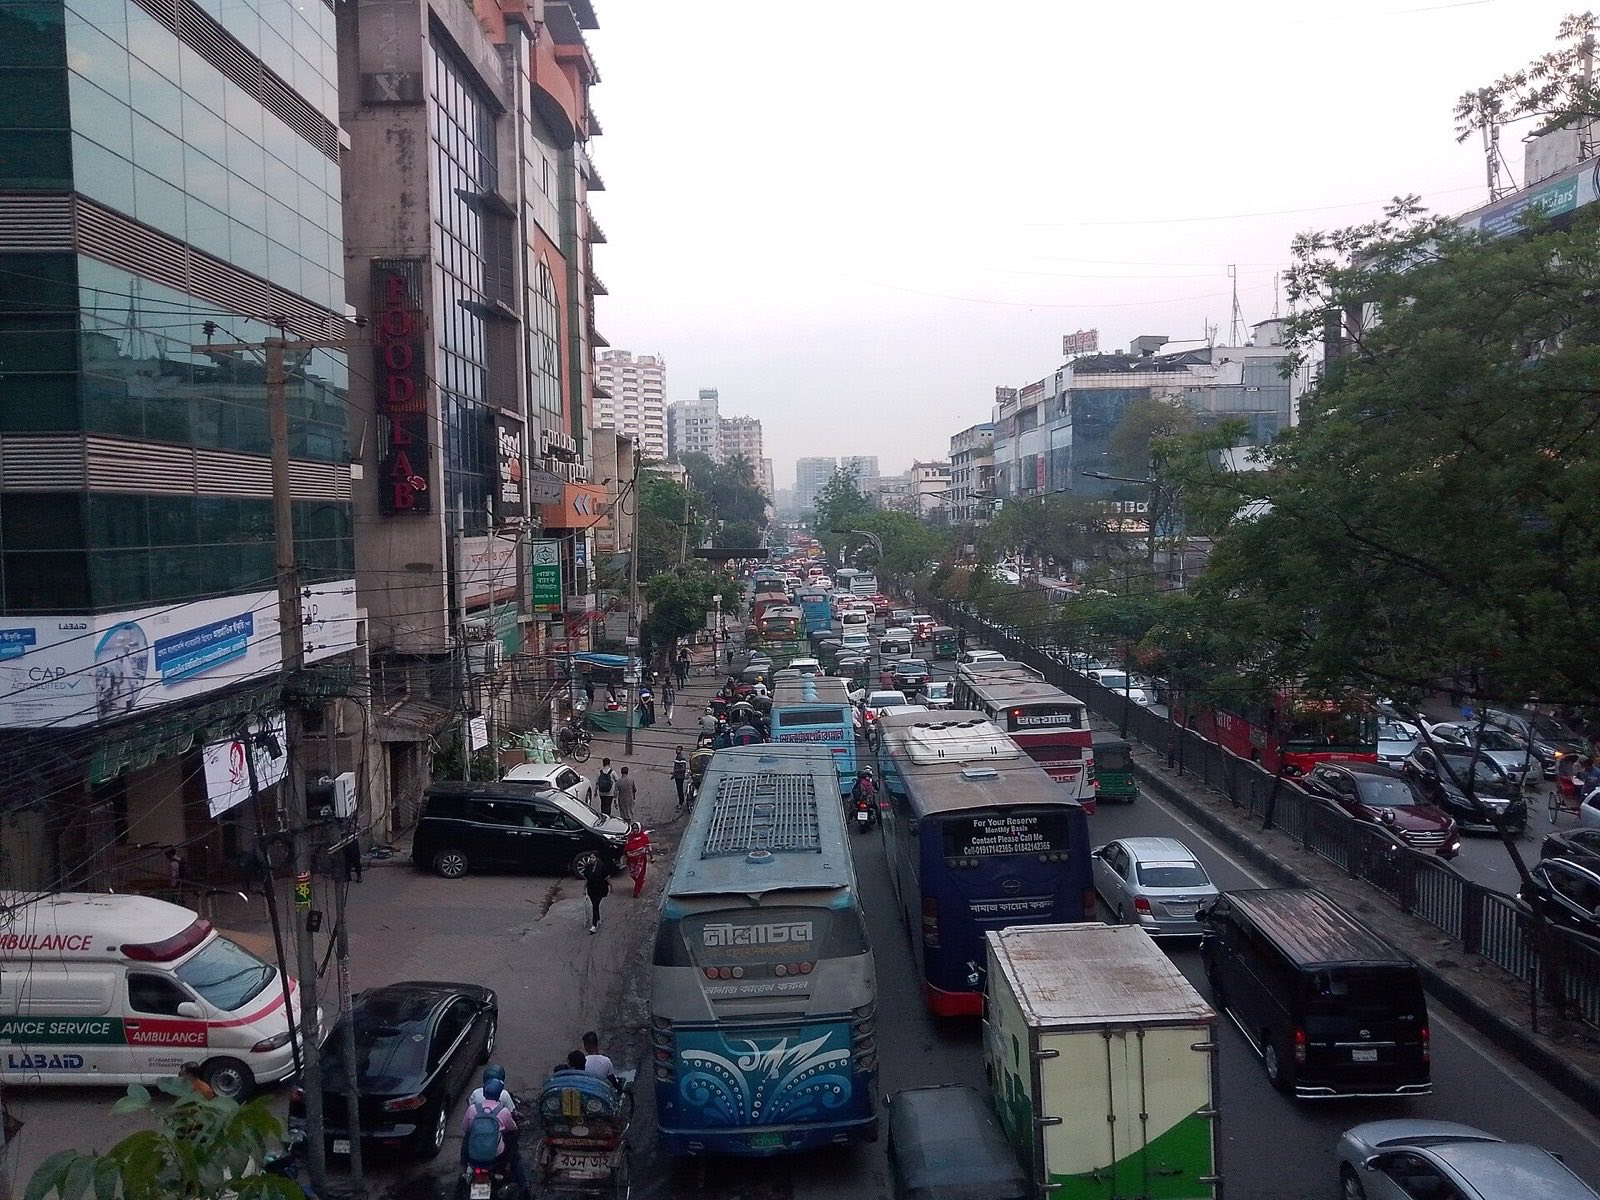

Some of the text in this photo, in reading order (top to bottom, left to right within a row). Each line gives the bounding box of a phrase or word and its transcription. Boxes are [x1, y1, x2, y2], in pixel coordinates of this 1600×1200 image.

[28, 666, 66, 681] CAP
[973, 817, 1038, 827] For Your Reserve
[985, 826, 1010, 834] Monthly
[971, 836, 997, 845] Contact
[997, 834, 1019, 843] Please
[1019, 833, 1033, 842] Call
[969, 904, 998, 912] নামাজ
[703, 921, 814, 947] নীলাচল
[48, 1022, 111, 1035] SERVICE
[132, 1031, 205, 1043] AMBULANCE
[8, 1053, 84, 1069] LABAID
